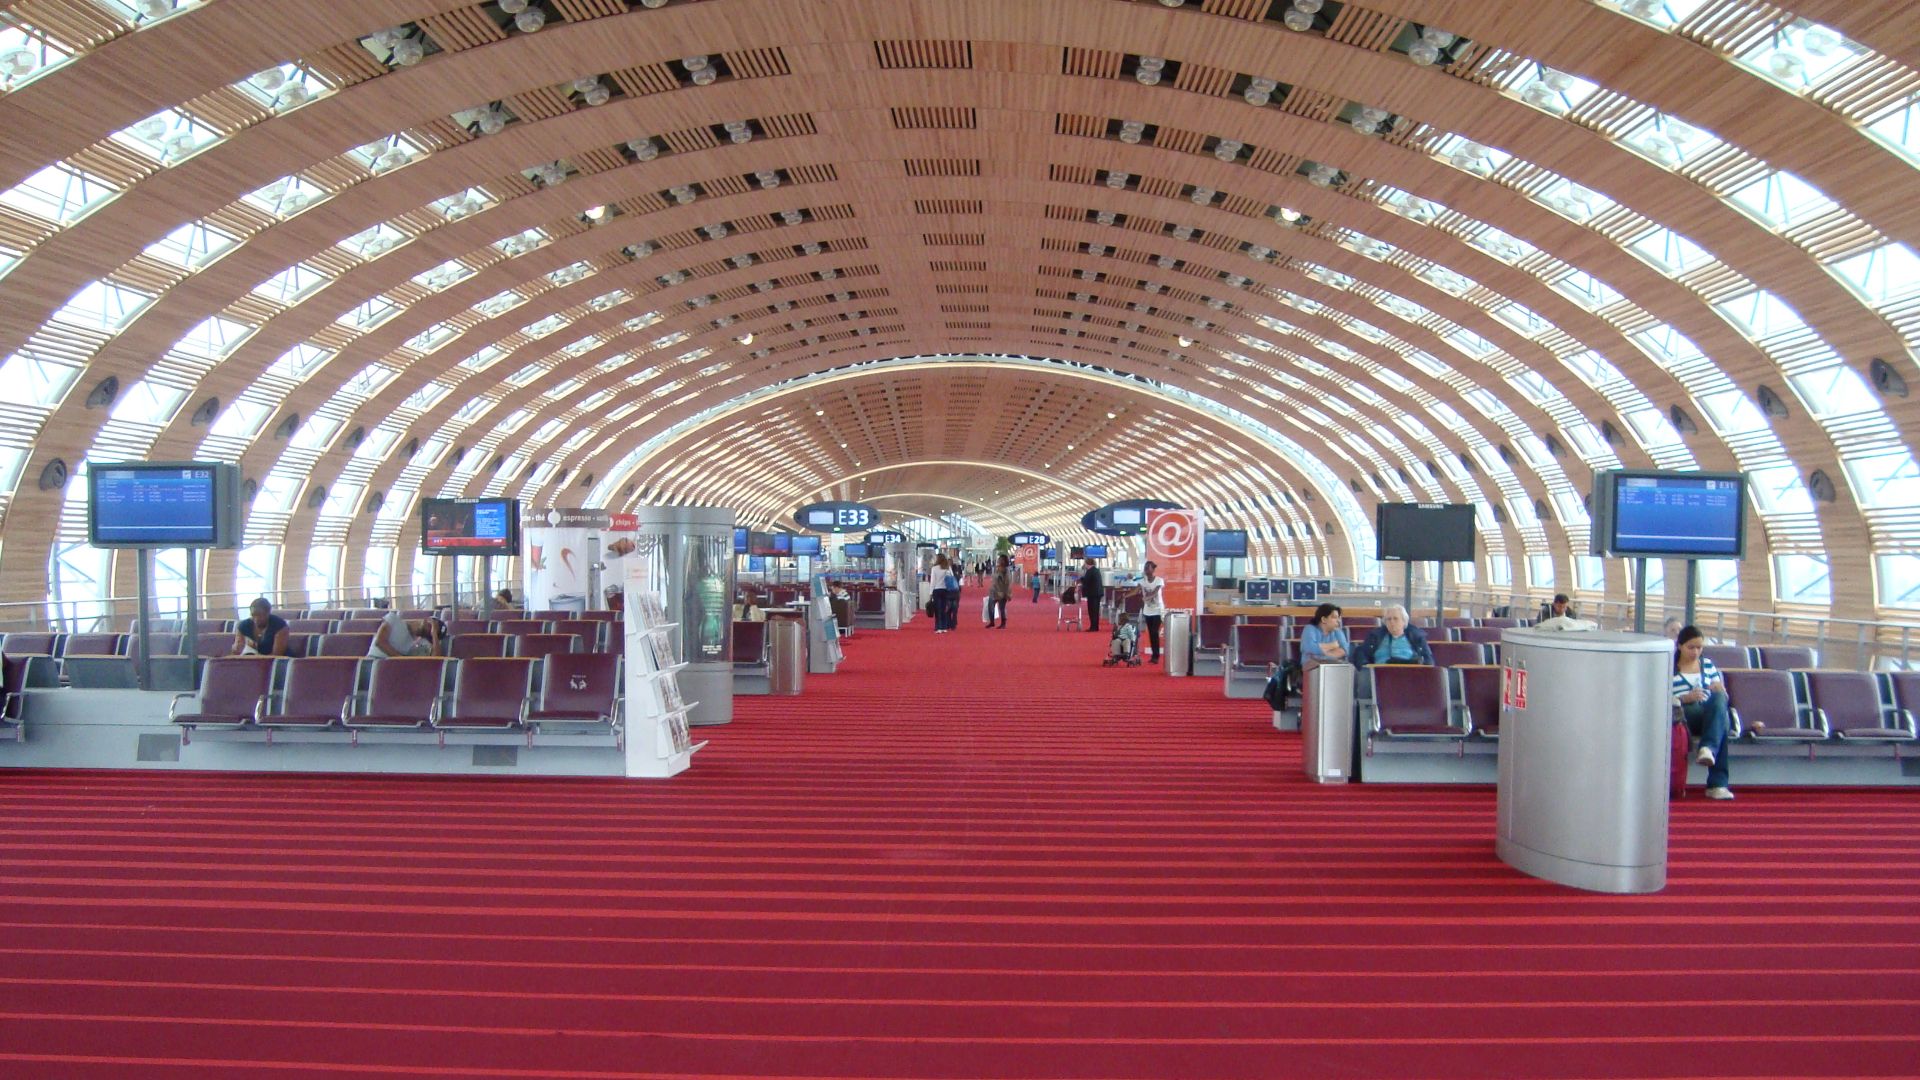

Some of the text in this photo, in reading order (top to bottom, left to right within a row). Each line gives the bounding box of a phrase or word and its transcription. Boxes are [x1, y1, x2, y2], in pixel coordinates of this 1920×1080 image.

[562, 514, 591, 522] espresso
[838, 509, 869, 526] E33
[885, 535, 901, 543] E34
[1149, 511, 1194, 558] @
[1029, 535, 1045, 544] E28
